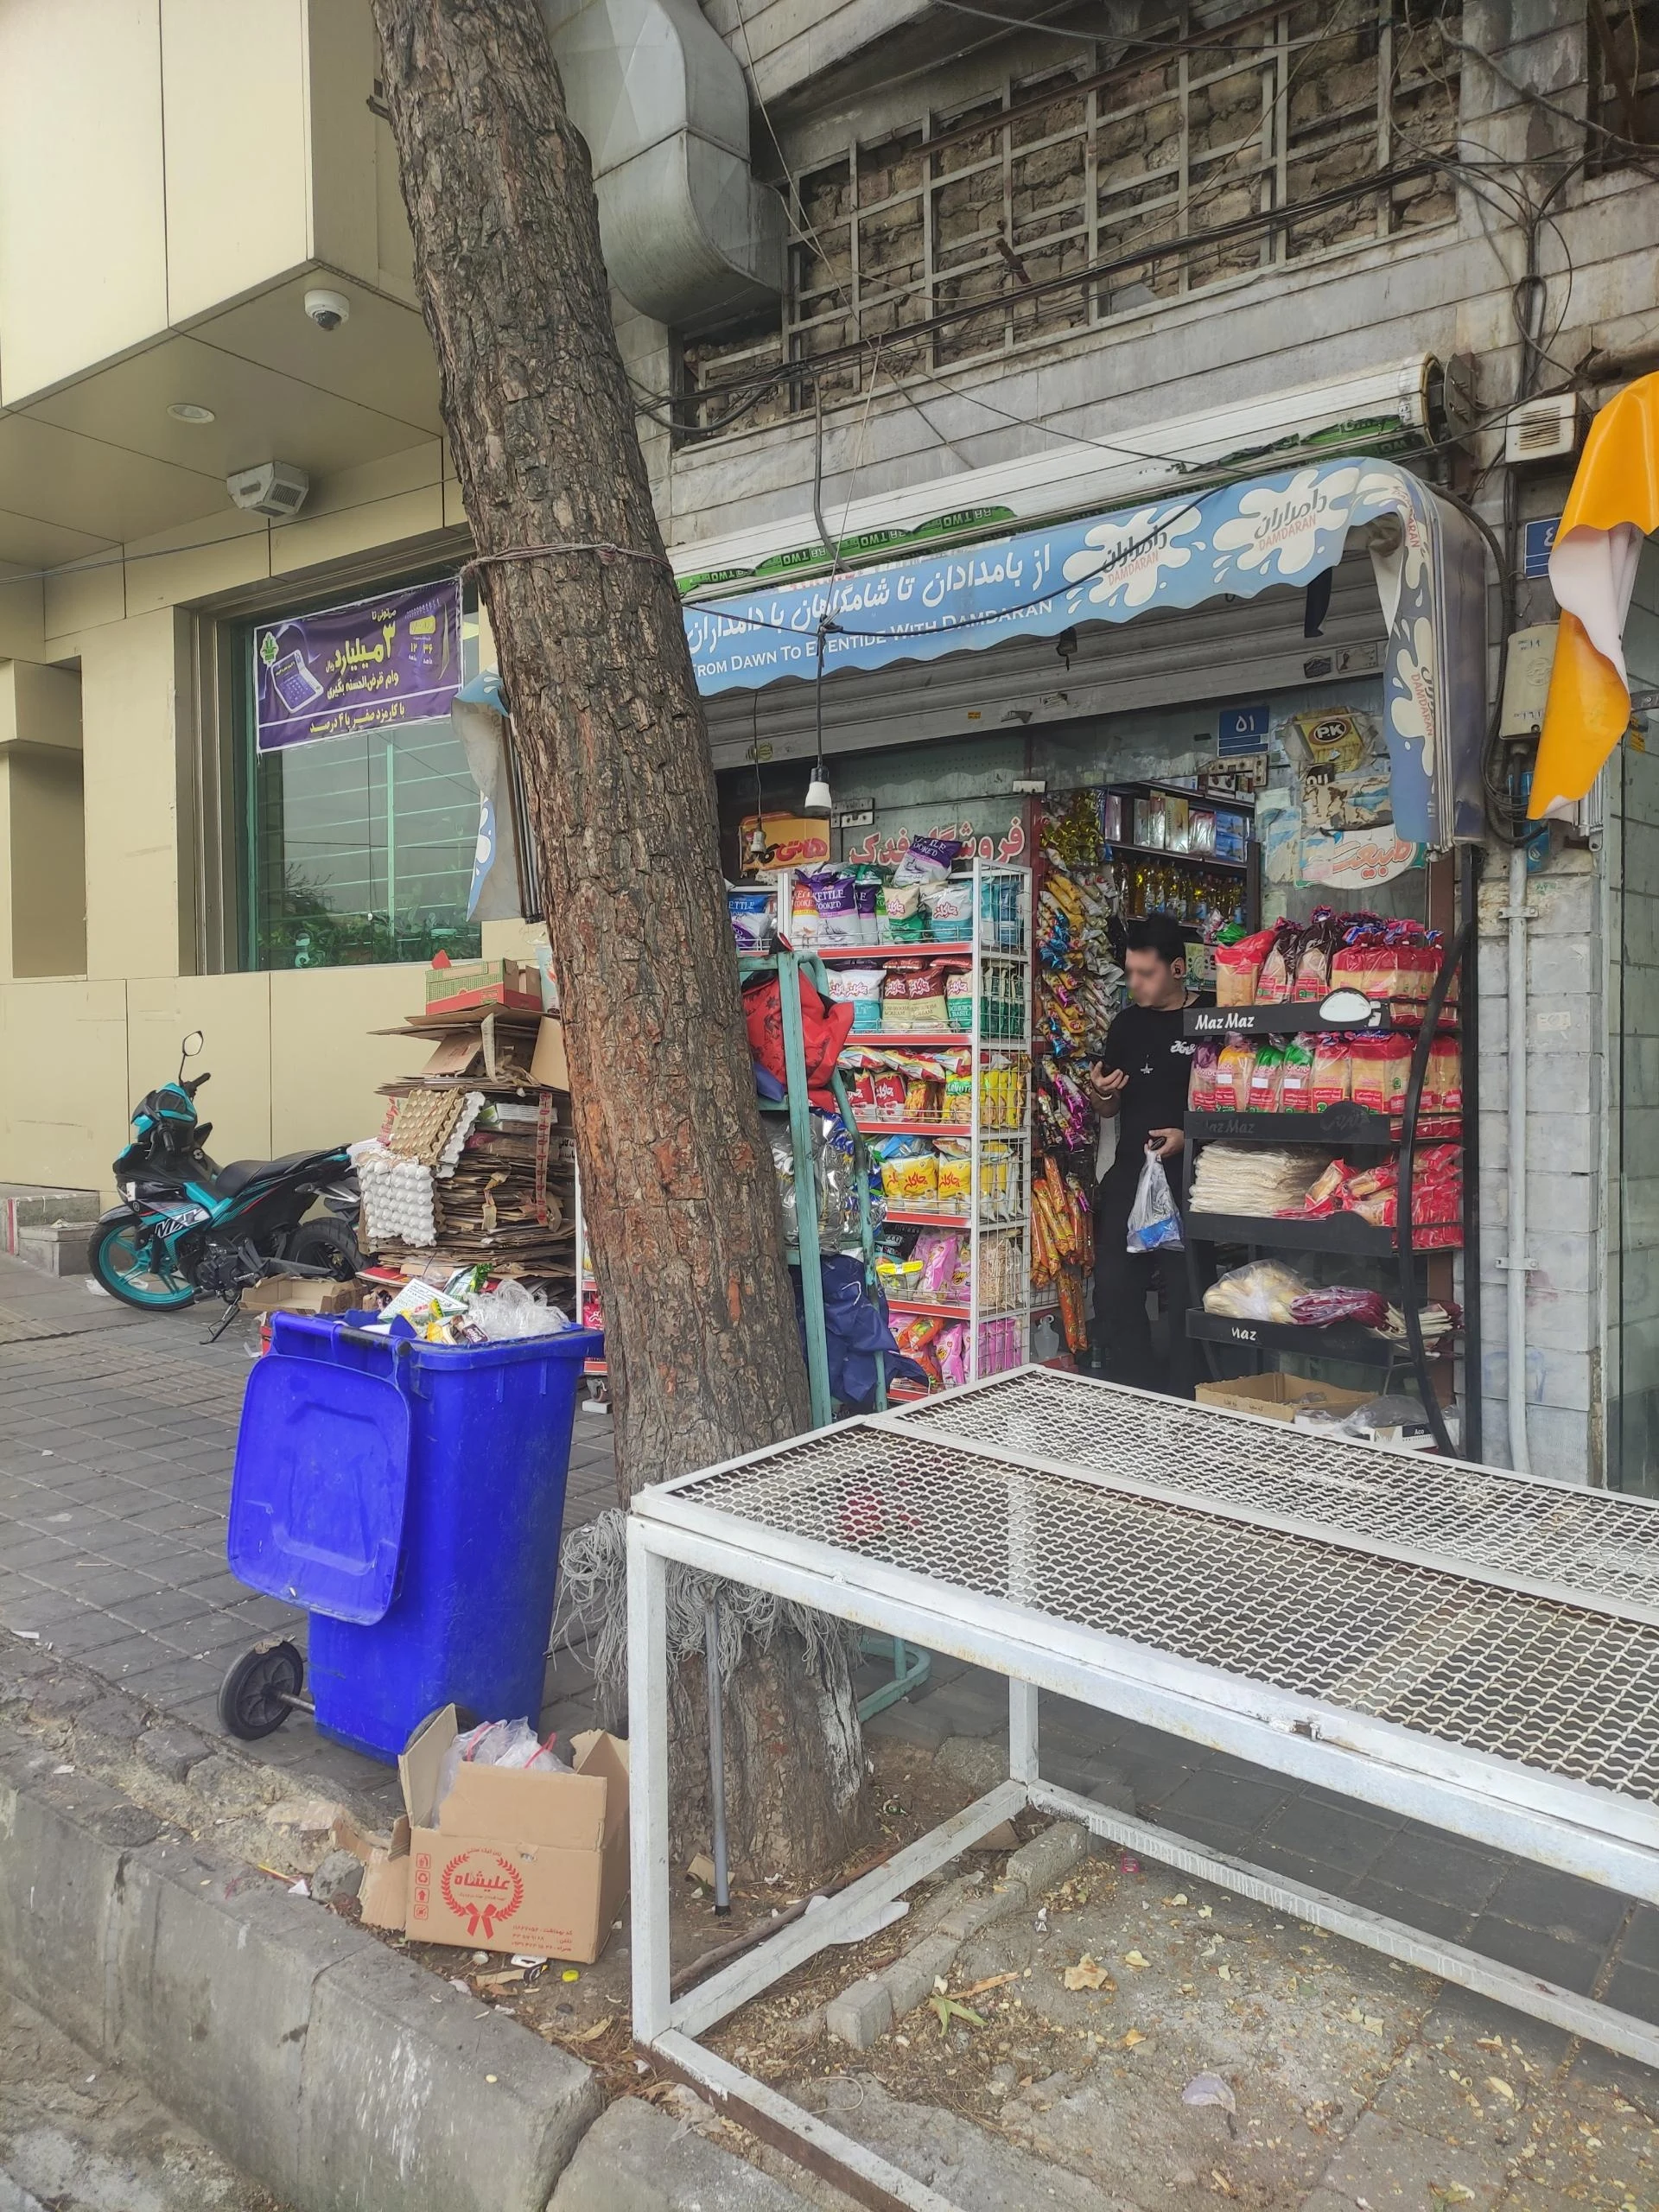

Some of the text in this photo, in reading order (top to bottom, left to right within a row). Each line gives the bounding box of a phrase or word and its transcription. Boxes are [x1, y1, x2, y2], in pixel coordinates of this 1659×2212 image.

[1259, 514, 1316, 551] DAMDARAN
[1033, 543, 1050, 591] از
[1108, 551, 1158, 587] DAMDARAN
[897, 575, 916, 601] تا
[922, 552, 1023, 607] بامدادان
[770, 602, 785, 633] با
[383, 621, 396, 658] ۳
[731, 652, 777, 671] DAWN
[890, 620, 937, 641] WITH
[942, 600, 1052, 632] DAMDARAN
[326, 660, 335, 673] ریال
[334, 639, 384, 676] میلیارد
[327, 678, 345, 699] بگیری
[385, 670, 399, 689] وام
[1411, 673, 1433, 736] DAMDARAN
[310, 719, 337, 734] درصد
[353, 709, 374, 727] صفر
[728, 900, 755, 910] ETTLE
[812, 889, 846, 902] KETTLE
[815, 901, 842, 910] COOKED
[1194, 1013, 1255, 1030] Maz Maz
[454, 1871, 511, 1892] علیشاه
